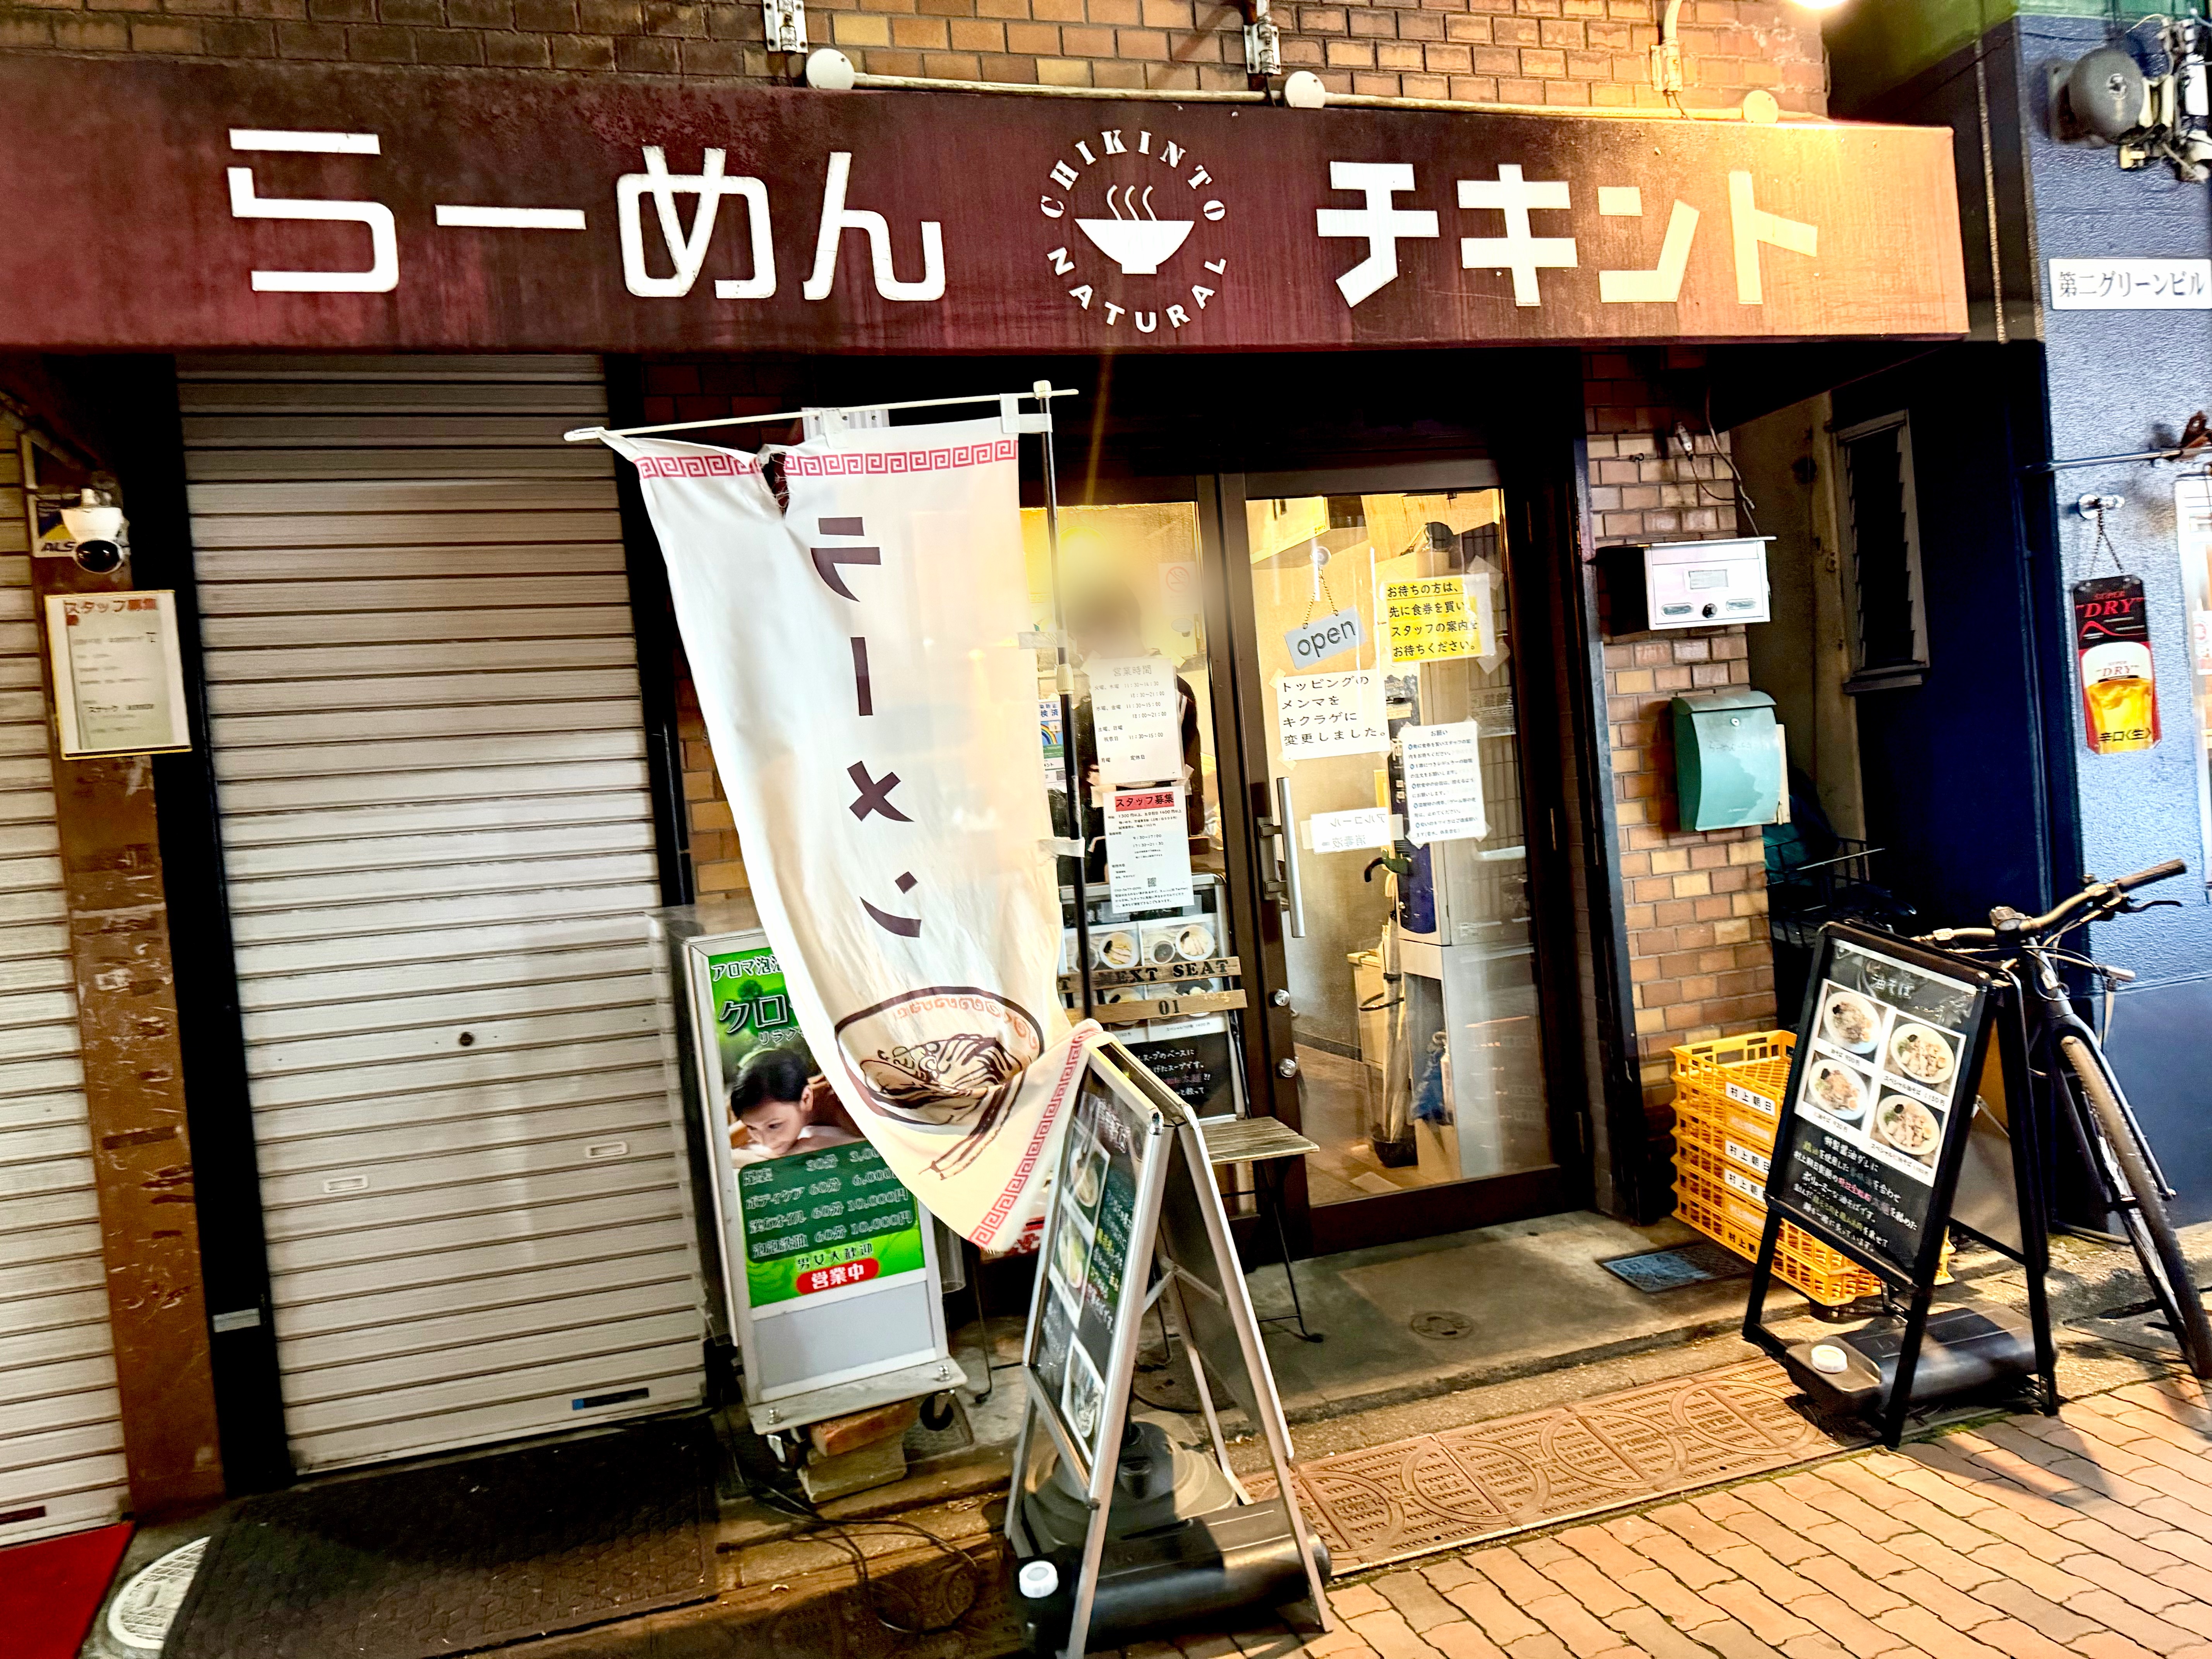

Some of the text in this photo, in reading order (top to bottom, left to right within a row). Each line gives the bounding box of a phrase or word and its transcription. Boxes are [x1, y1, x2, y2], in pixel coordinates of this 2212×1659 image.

[1041, 130, 1225, 221] CHIKINTO
[227, 129, 945, 302] らーめん
[1317, 161, 1818, 307] チキント
[1047, 247, 1226, 333] NATURAL
[2058, 271, 2205, 297] 第二グリーンビル
[41, 542, 76, 552] ALS
[1387, 582, 1458, 598] お待ちの方は、
[1389, 601, 1470, 618] 先に食券を買い
[1297, 621, 1356, 658] open
[1393, 641, 1475, 658] お待ちください。
[1113, 665, 1152, 677] 営業時間
[1283, 675, 1369, 692] トッピングの
[1282, 696, 1340, 710] メンマを
[1041, 709, 1058, 717] 検済
[1283, 712, 1357, 727] キクラゲに
[810, 517, 921, 938] ラーメン
[1284, 727, 1385, 746] 変更しました。
[1116, 794, 1174, 807] スタッフ募集
[1173, 959, 1228, 978] SEAT
[719, 994, 789, 1034] クロ
[1158, 1000, 1180, 1015] 01
[1731, 1086, 1772, 1111] 村上朝日
[1729, 1173, 1758, 1196] 村上朝
[1728, 1232, 1757, 1254] 村上朝
[811, 1263, 864, 1290] 営業中
